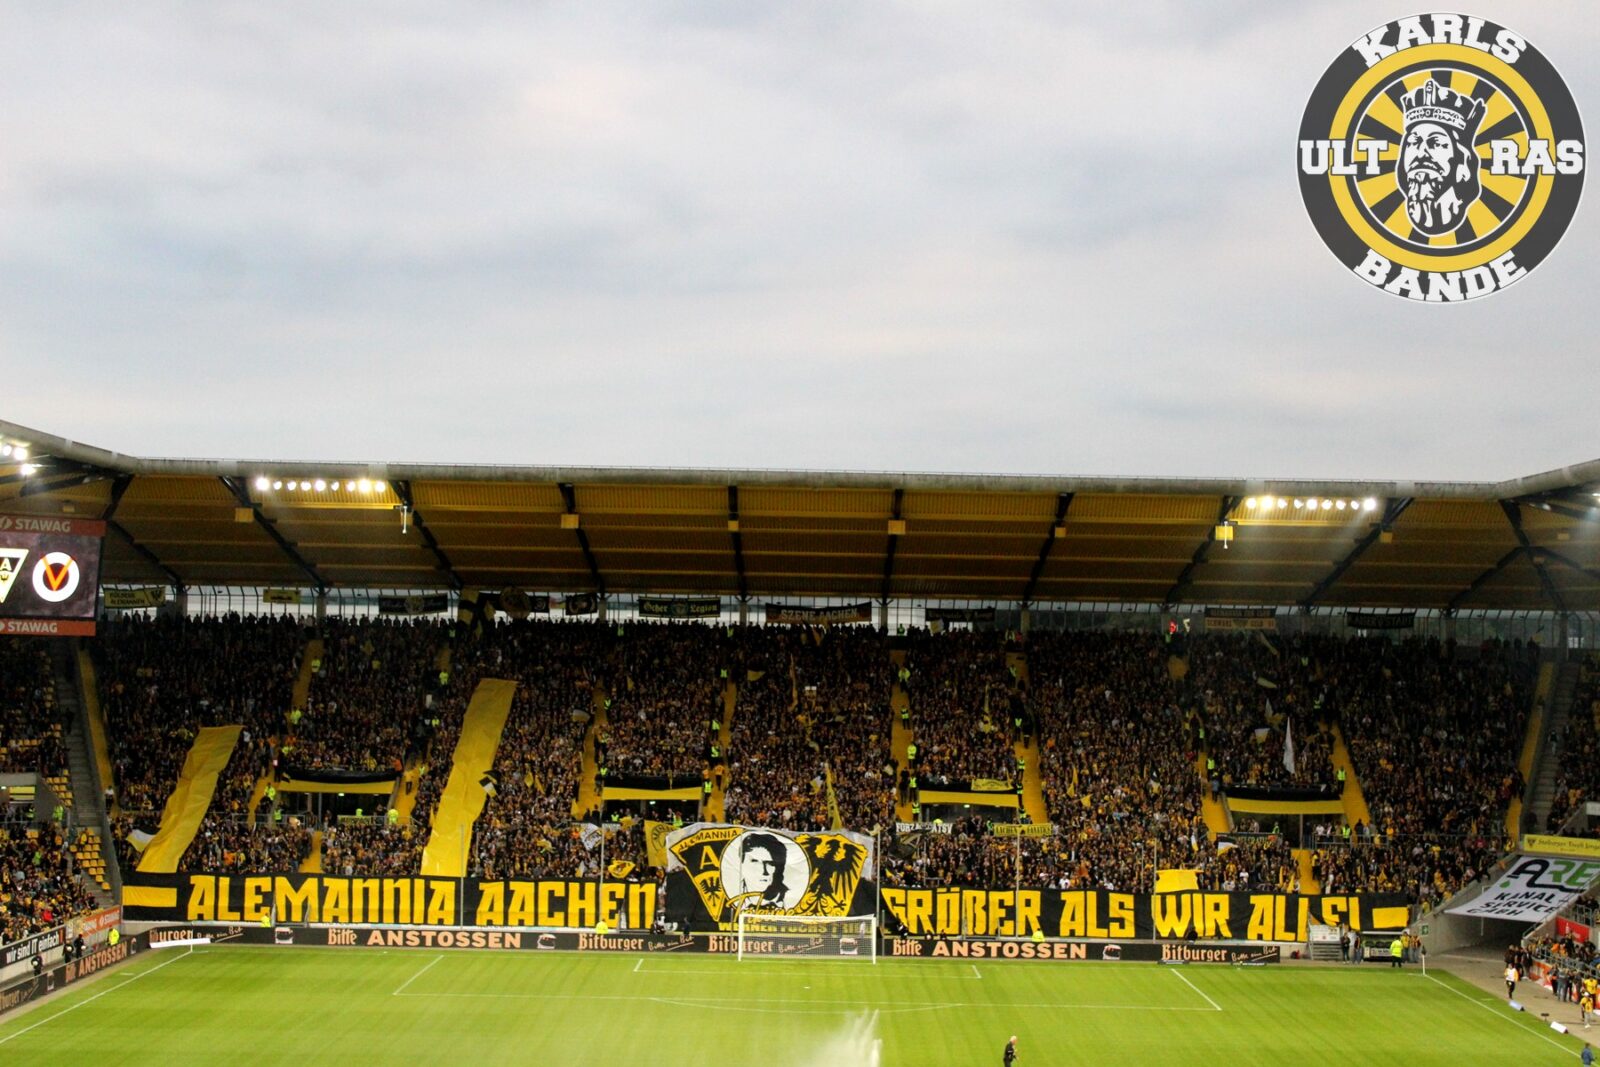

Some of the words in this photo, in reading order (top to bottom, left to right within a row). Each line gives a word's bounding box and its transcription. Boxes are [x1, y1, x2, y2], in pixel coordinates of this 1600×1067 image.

[15, 519, 71, 532] STAWAG
[780, 608, 817, 621] SZENE
[7, 621, 58, 633] STAWAG
[187, 875, 455, 925] ALEMANNIA
[476, 881, 656, 929] AACHEN
[1059, 891, 1135, 938] ALS
[1153, 893, 1232, 938] WIR
[327, 928, 358, 946] Bitte
[367, 929, 521, 949] ANSTOSSEN
[578, 932, 643, 951] Bitburger
[892, 938, 922, 956] Bitte
[932, 941, 1086, 959] ANSTOSSEN
[78, 941, 127, 977] ANSTOSSEN
[1161, 943, 1227, 962] Bitburger
